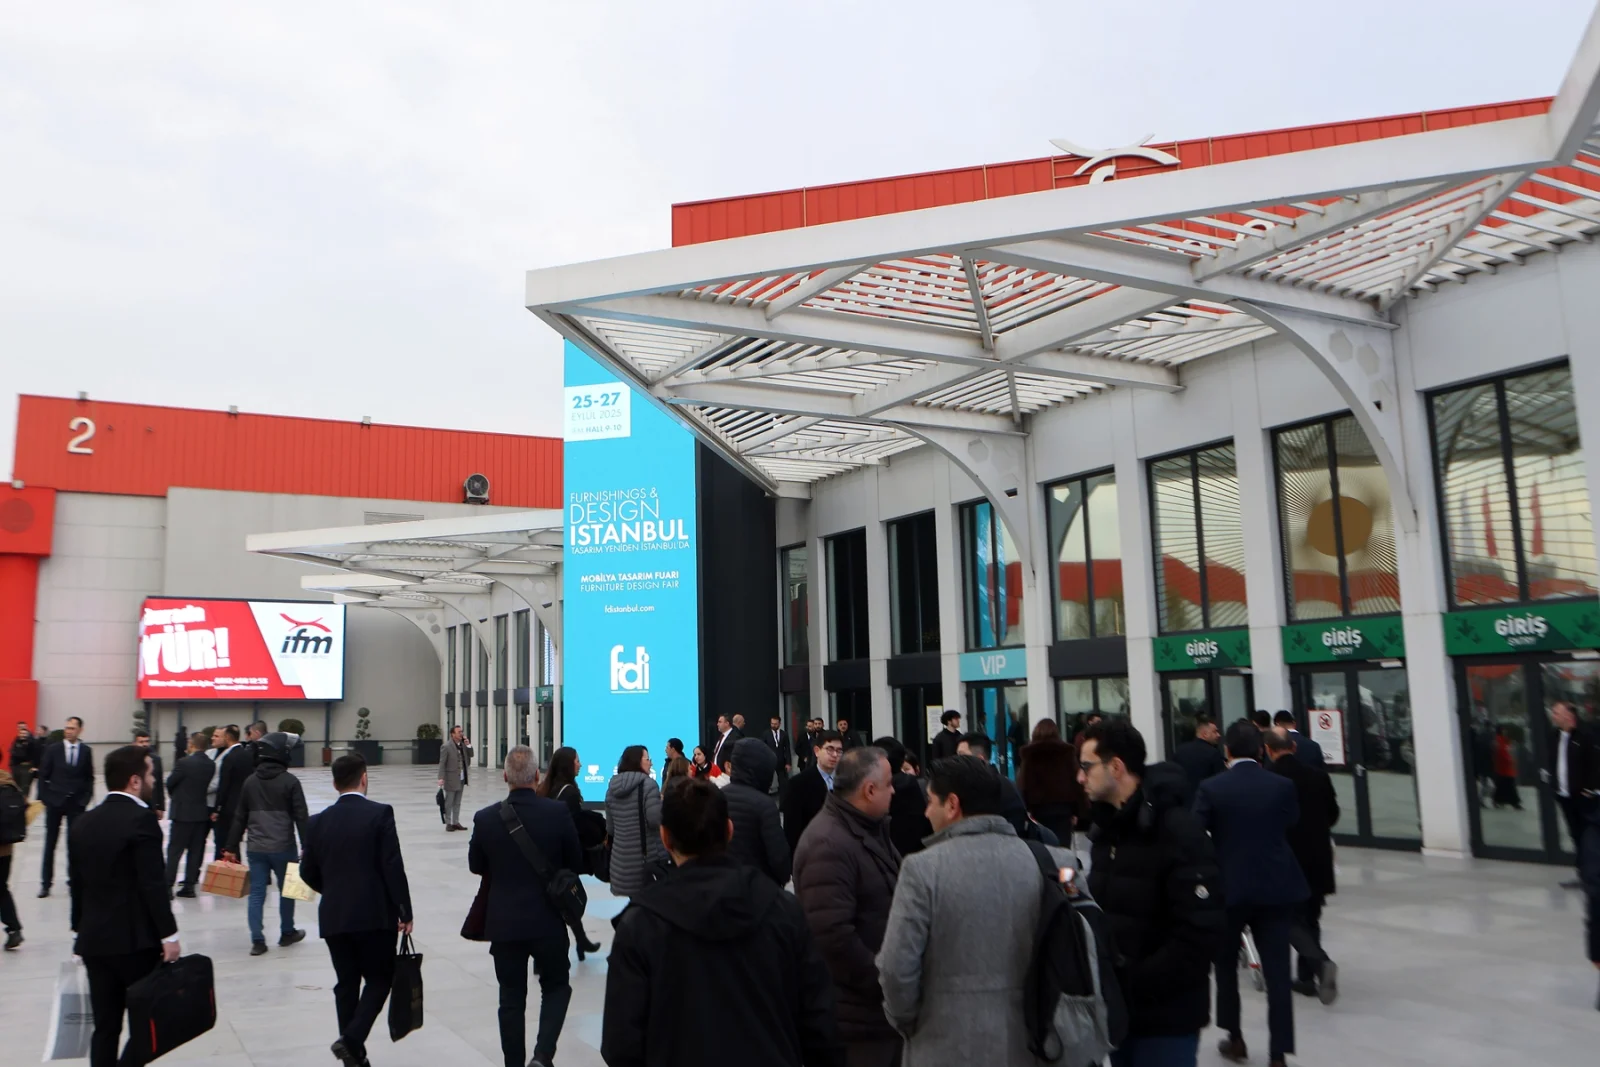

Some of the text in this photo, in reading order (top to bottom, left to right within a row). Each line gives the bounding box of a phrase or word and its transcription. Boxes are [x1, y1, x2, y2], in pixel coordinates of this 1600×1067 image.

[572, 392, 621, 409] 25-27
[599, 409, 622, 419] 2025
[67, 416, 96, 455] 2
[570, 487, 658, 503] FURNISHINGS &
[570, 498, 659, 525] DESIGN
[570, 519, 689, 546] ISTANBUL
[571, 546, 603, 554] TASARIM
[618, 572, 653, 581] TASARIM
[655, 571, 679, 579] FUARI
[580, 580, 679, 592] FURNITURE DESIGN FAIR
[604, 604, 655, 613] fdistanbul.com
[281, 628, 332, 654] ifm
[610, 644, 650, 690] fdi
[979, 654, 1007, 676] VIP
